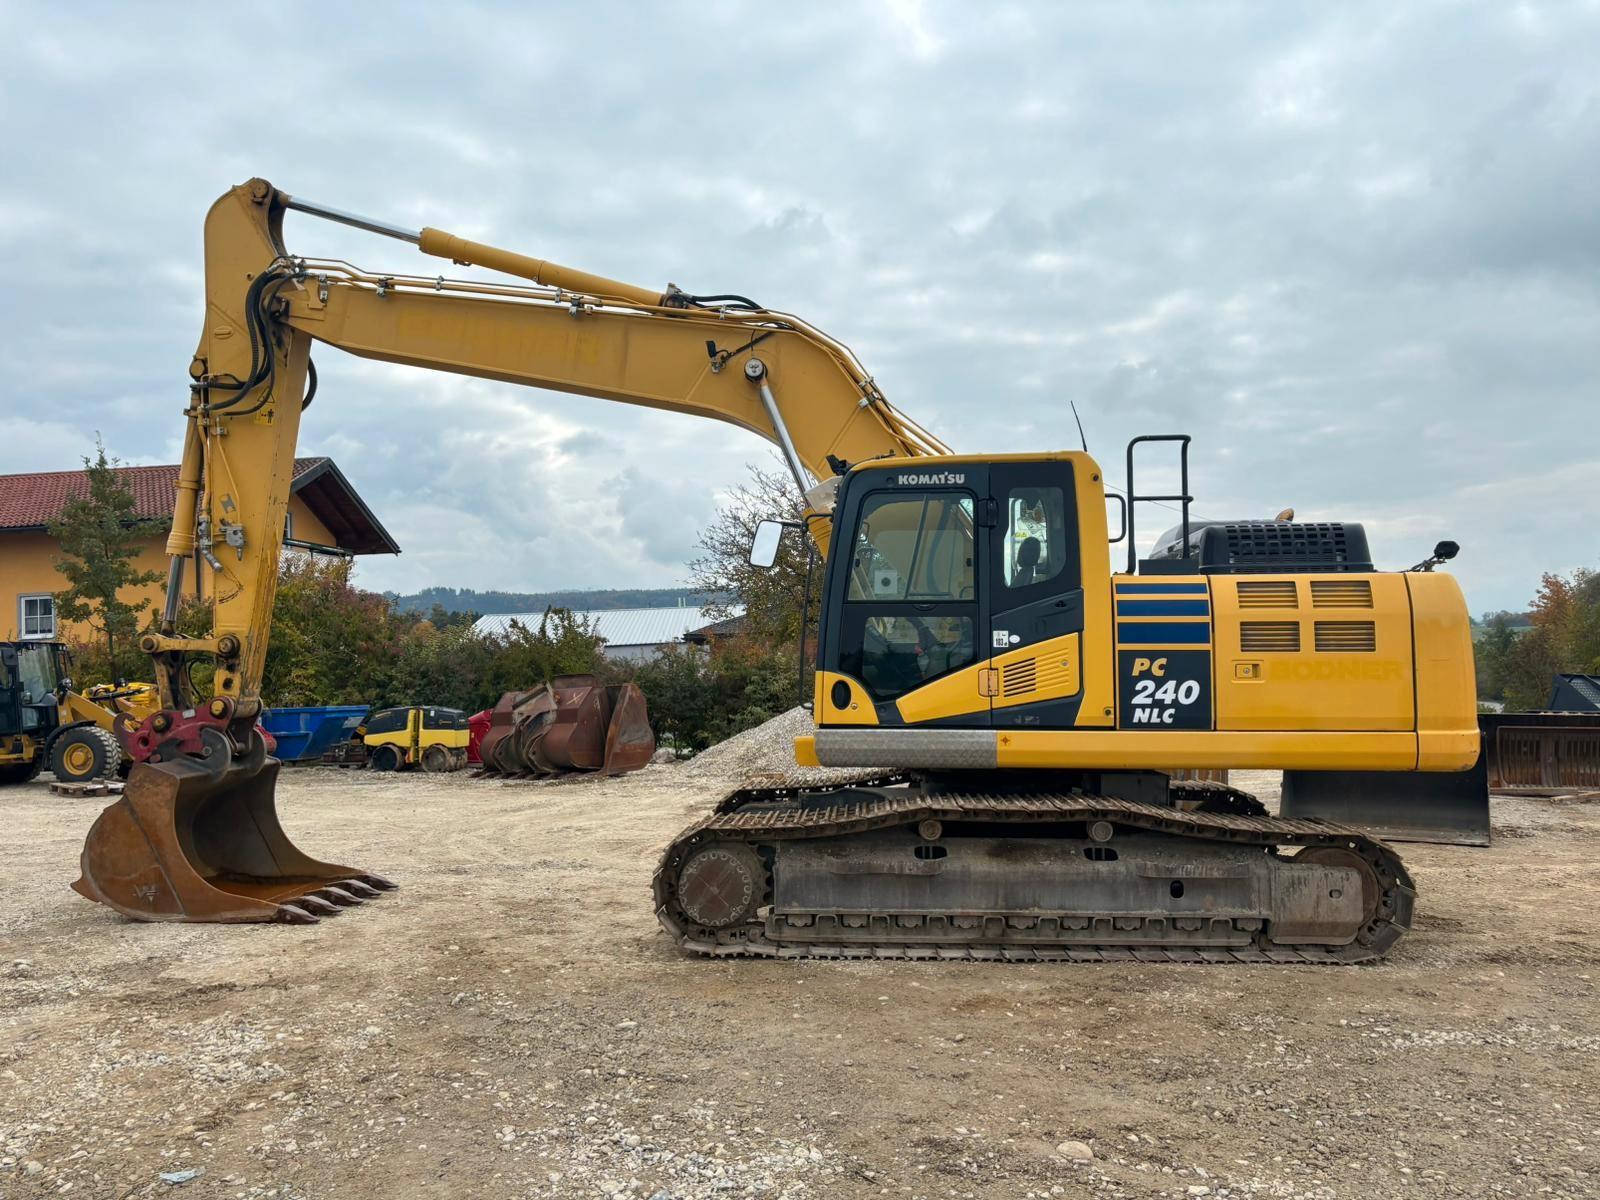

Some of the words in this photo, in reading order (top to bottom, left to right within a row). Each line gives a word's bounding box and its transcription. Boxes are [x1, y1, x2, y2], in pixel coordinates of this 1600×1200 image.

[898, 471, 965, 485] KOMATSU
[1131, 657, 1168, 677] PC
[1130, 679, 1201, 705] 240
[1132, 707, 1176, 724] NLC
